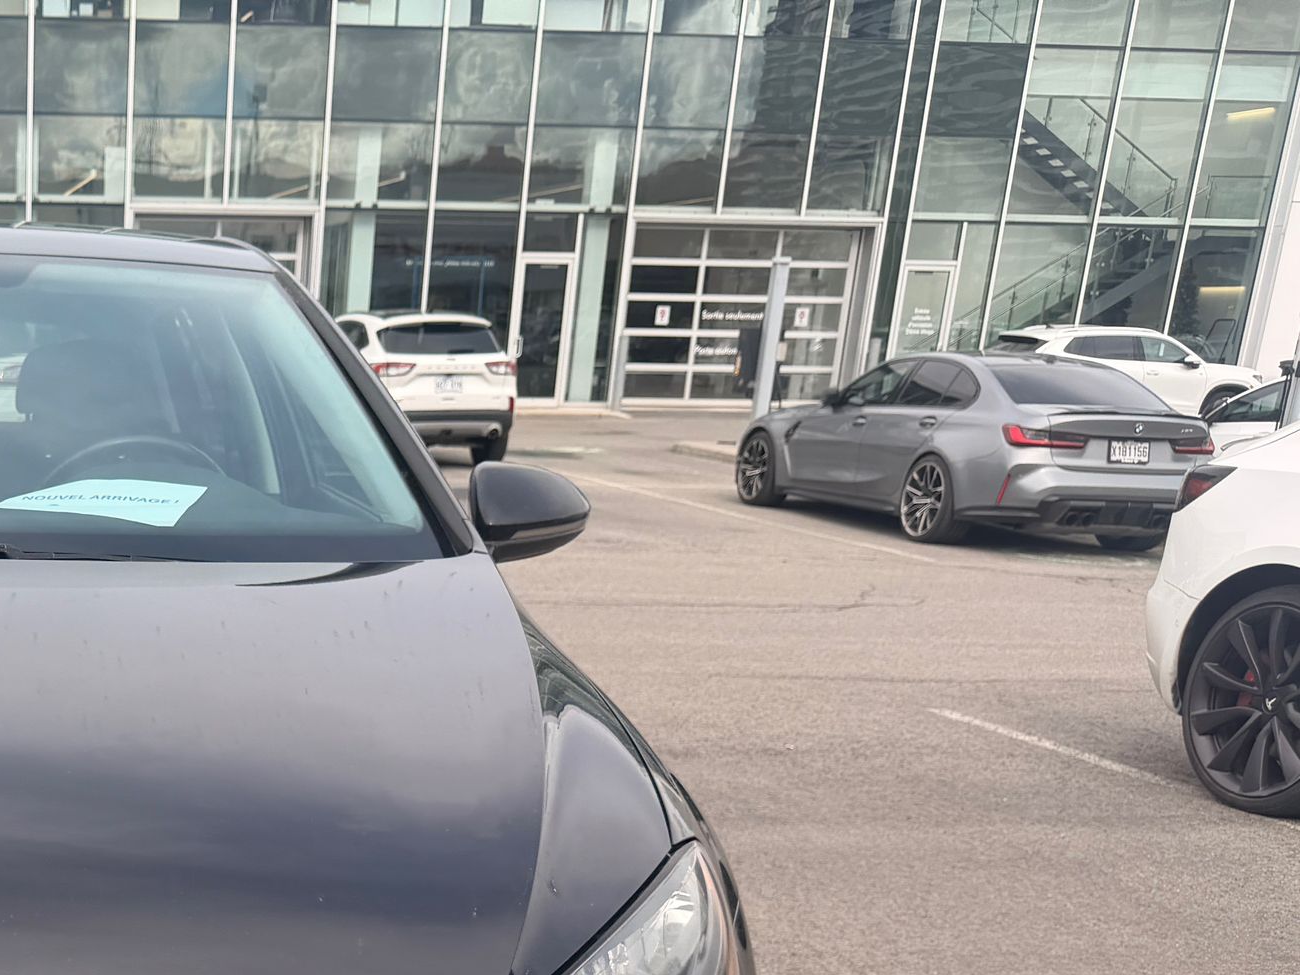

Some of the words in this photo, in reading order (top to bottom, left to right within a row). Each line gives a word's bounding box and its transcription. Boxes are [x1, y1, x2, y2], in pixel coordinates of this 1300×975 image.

[701, 309, 724, 320] Sortie
[725, 309, 764, 320] seulement
[89, 494, 173, 504] ARRIVAGE
